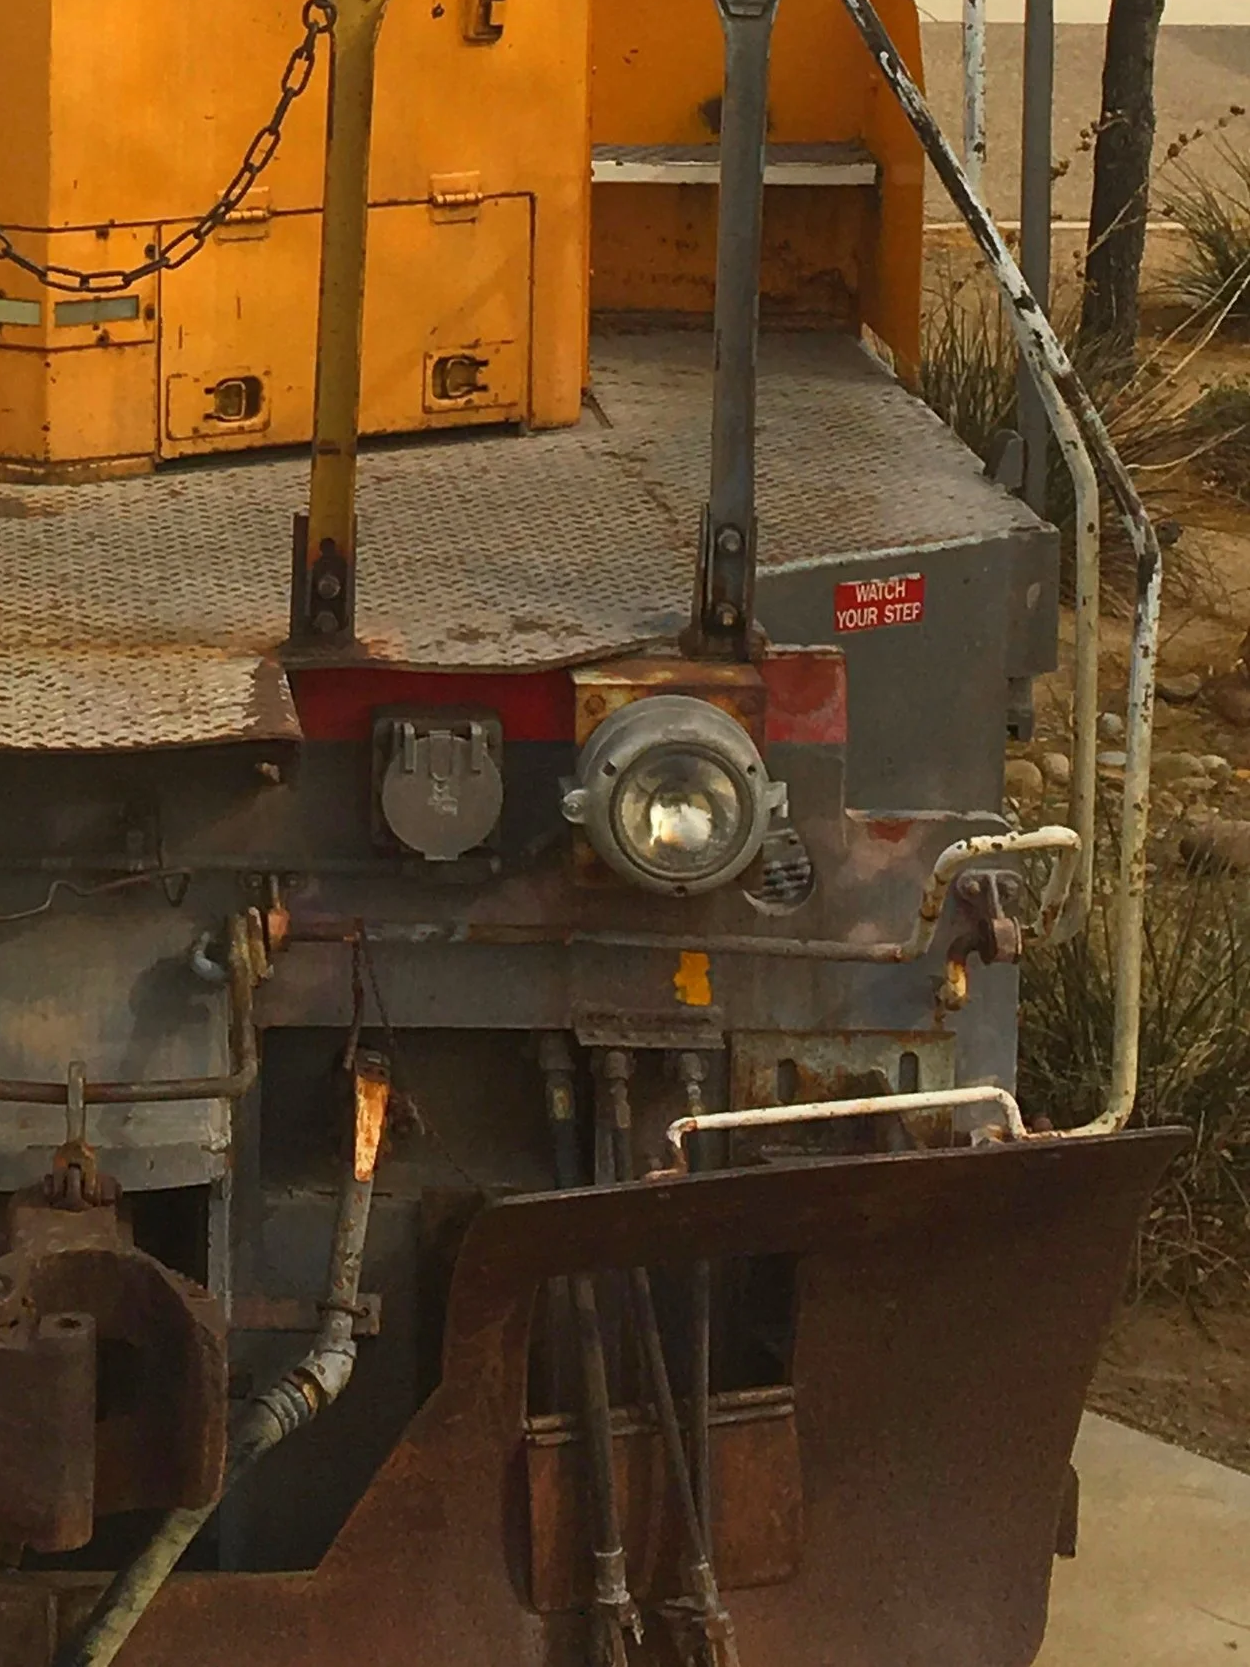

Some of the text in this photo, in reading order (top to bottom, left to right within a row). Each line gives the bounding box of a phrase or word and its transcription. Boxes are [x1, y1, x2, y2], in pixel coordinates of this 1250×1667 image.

[855, 581, 906, 603] WATCH
[836, 602, 922, 629] YOUR STEP
